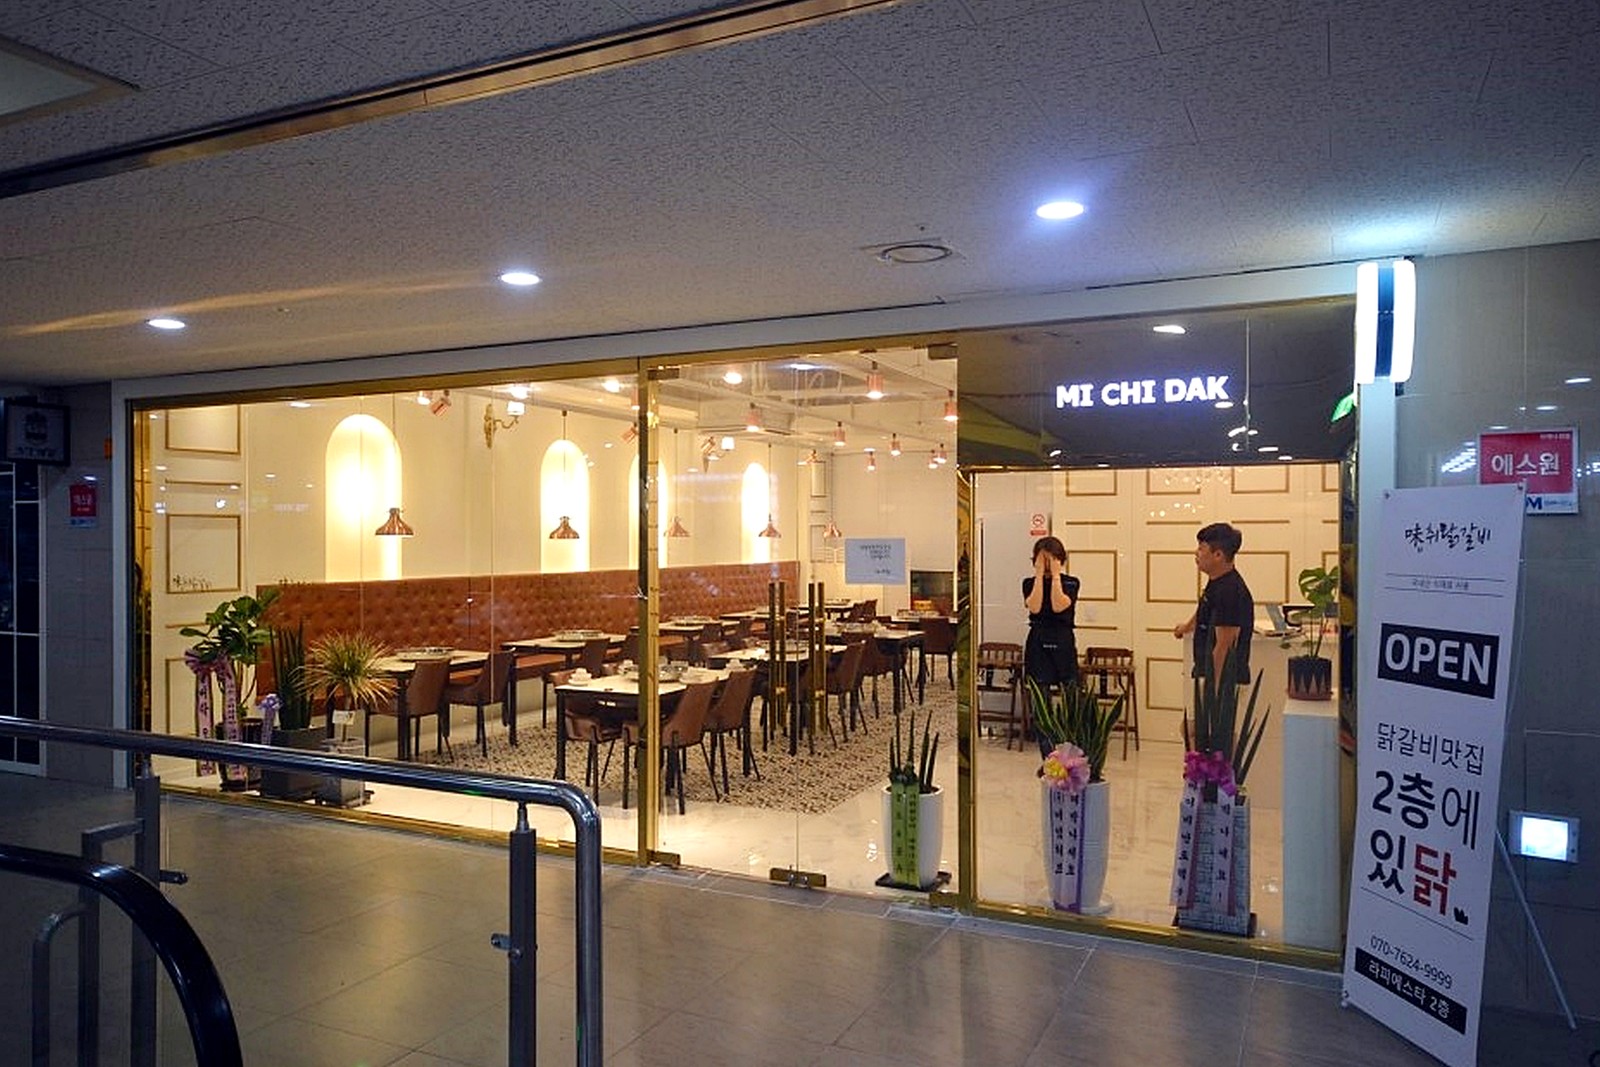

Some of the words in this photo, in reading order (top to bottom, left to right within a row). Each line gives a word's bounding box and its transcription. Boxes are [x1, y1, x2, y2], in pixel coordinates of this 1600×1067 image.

[1056, 383, 1094, 409] MI
[1101, 379, 1157, 406] CHI
[1164, 375, 1229, 403] DAK
[1491, 451, 1560, 476] 에스원
[1384, 633, 1492, 685] OPEN
[1377, 722, 1485, 776] 닭갈비맛집
[1371, 770, 1480, 850] 2층에
[1367, 829, 1457, 916] 있닭
[1429, 994, 1451, 1020] 2층
